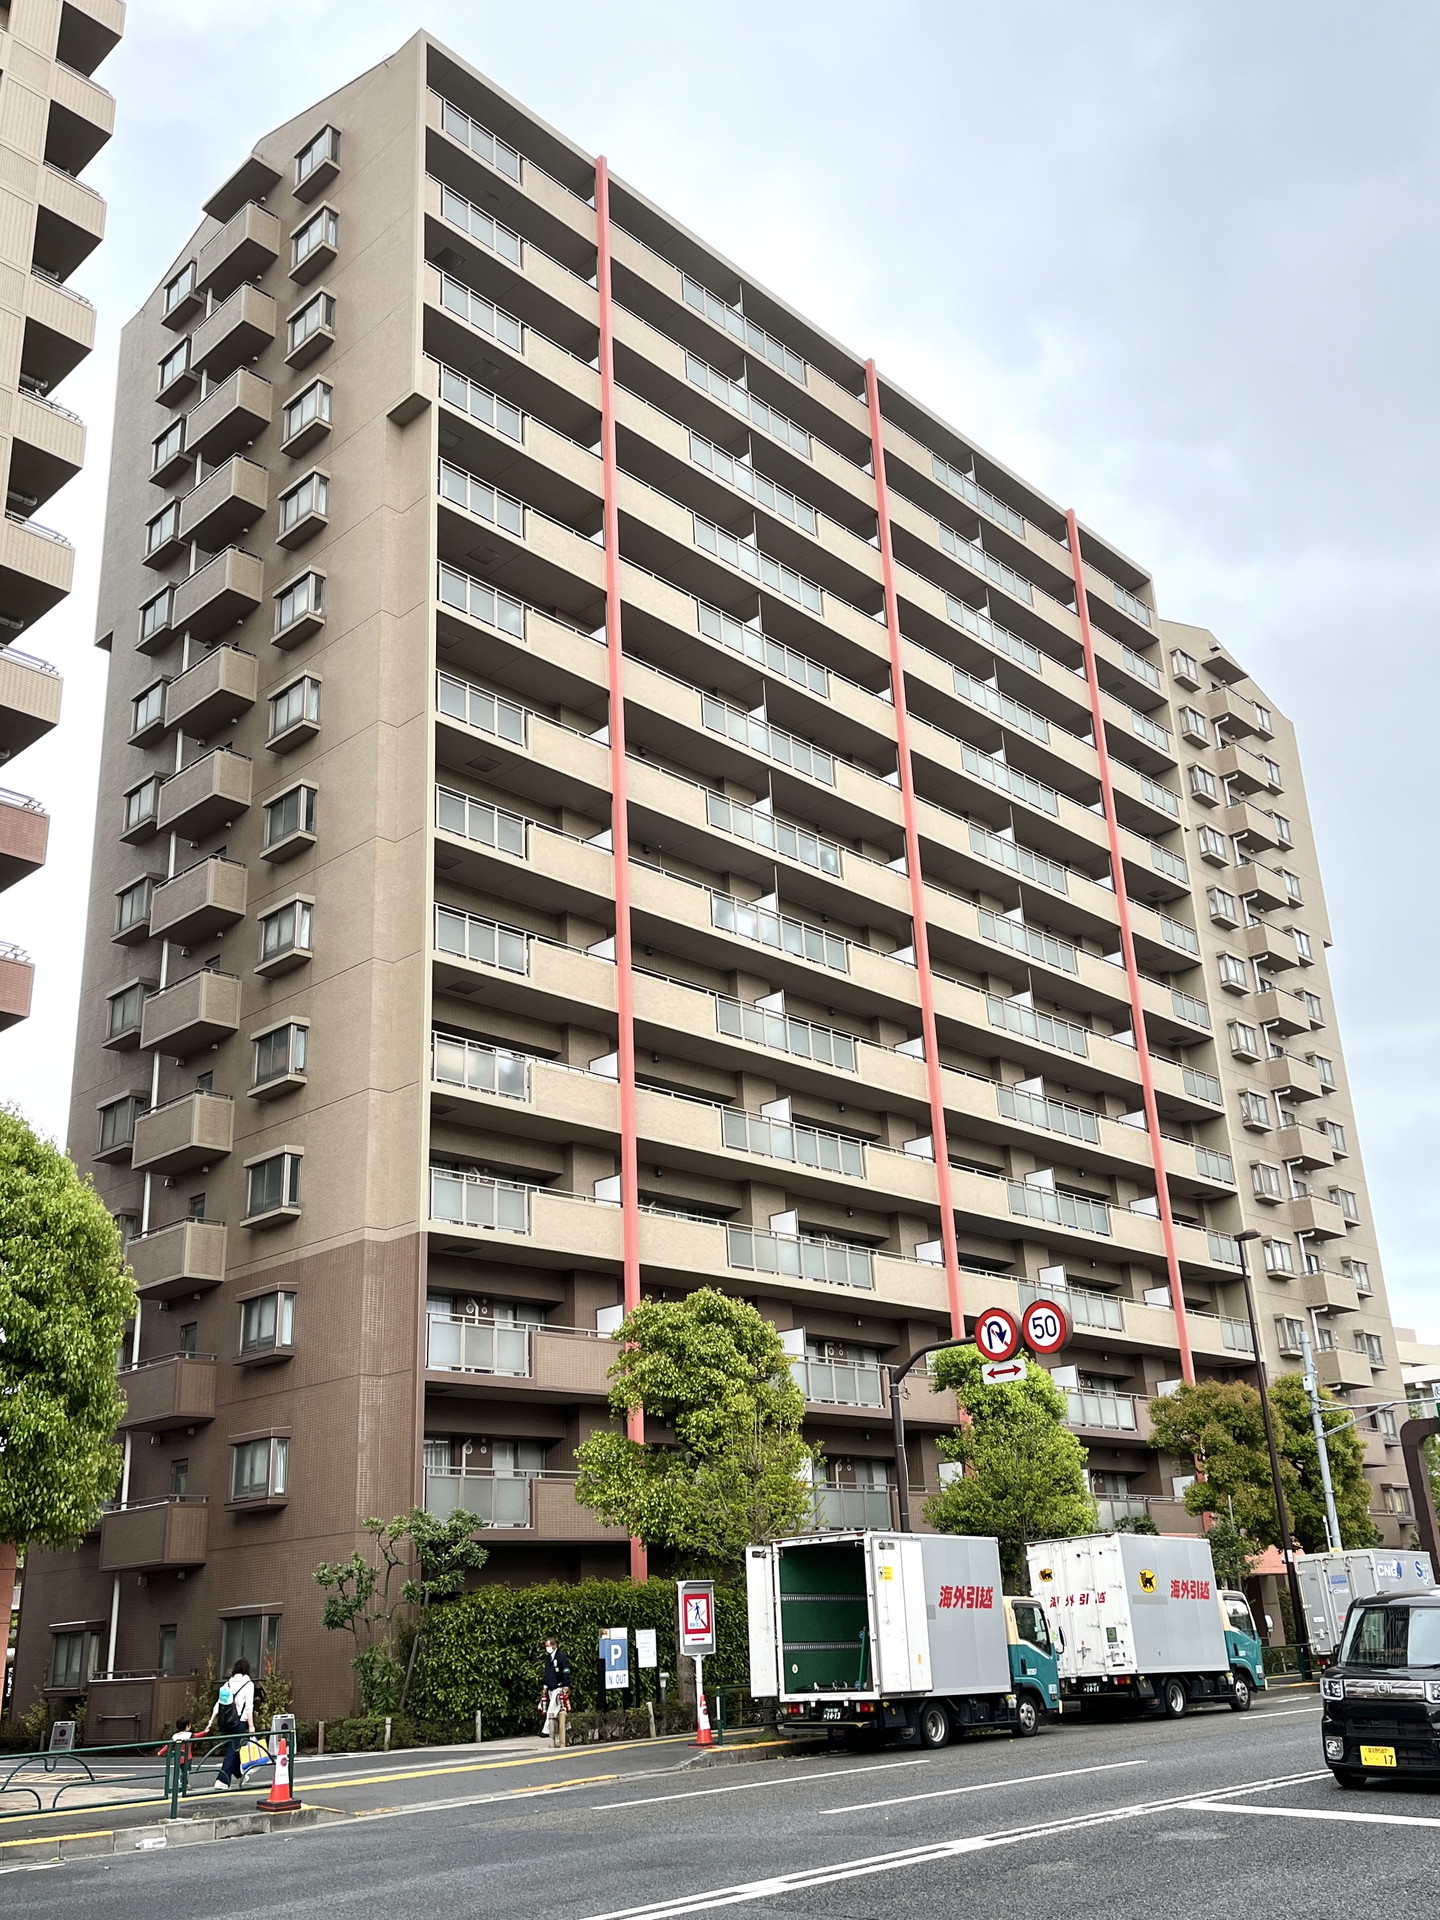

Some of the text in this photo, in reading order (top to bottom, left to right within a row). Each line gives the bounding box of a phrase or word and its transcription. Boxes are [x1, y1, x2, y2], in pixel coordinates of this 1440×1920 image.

[1032, 1315, 1057, 1340] 50
[1377, 1564, 1397, 1577] CNG
[938, 1585, 994, 1609] 海外引越
[1170, 1580, 1210, 1600] 海外引越
[610, 1644, 622, 1666] P
[615, 1673, 627, 1685] OUT
